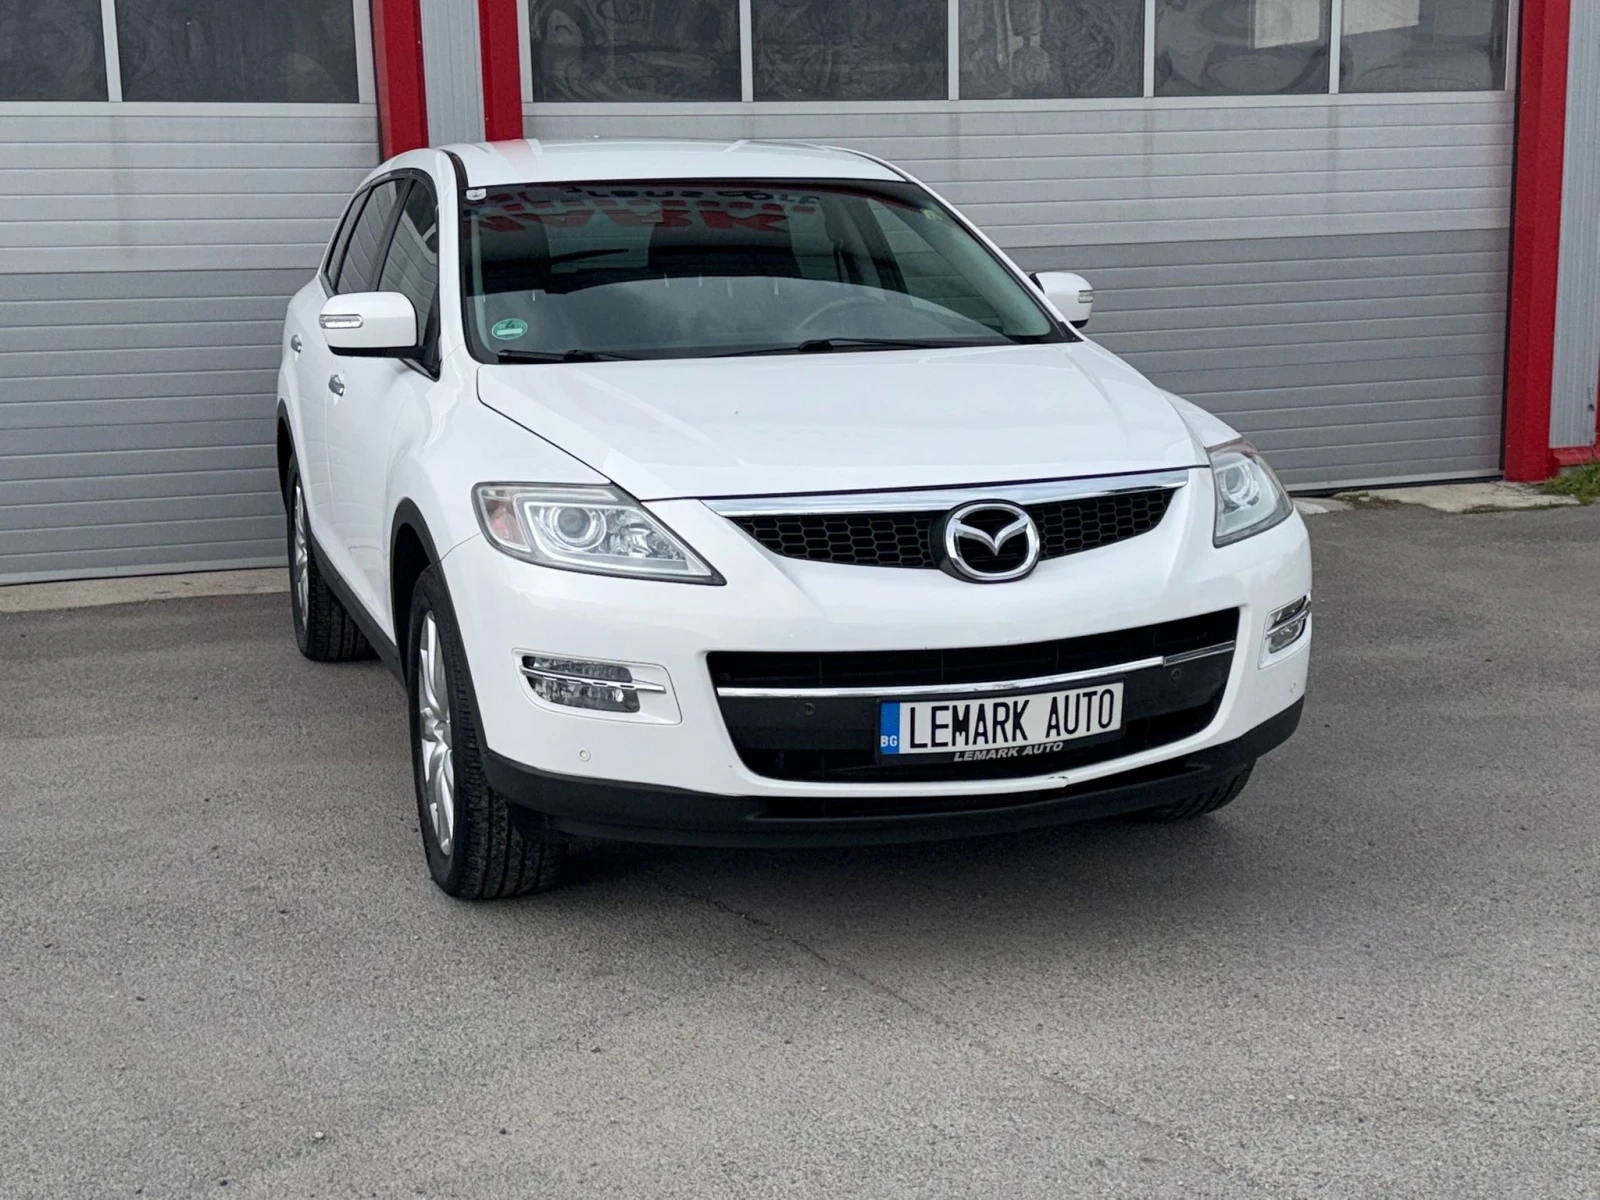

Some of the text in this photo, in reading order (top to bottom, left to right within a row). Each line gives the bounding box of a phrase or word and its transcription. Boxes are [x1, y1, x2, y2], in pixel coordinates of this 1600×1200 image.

[909, 688, 1115, 749] LEMARK AUTO
[880, 735, 898, 748] BG
[953, 741, 1064, 762] LEMARK AUTO
